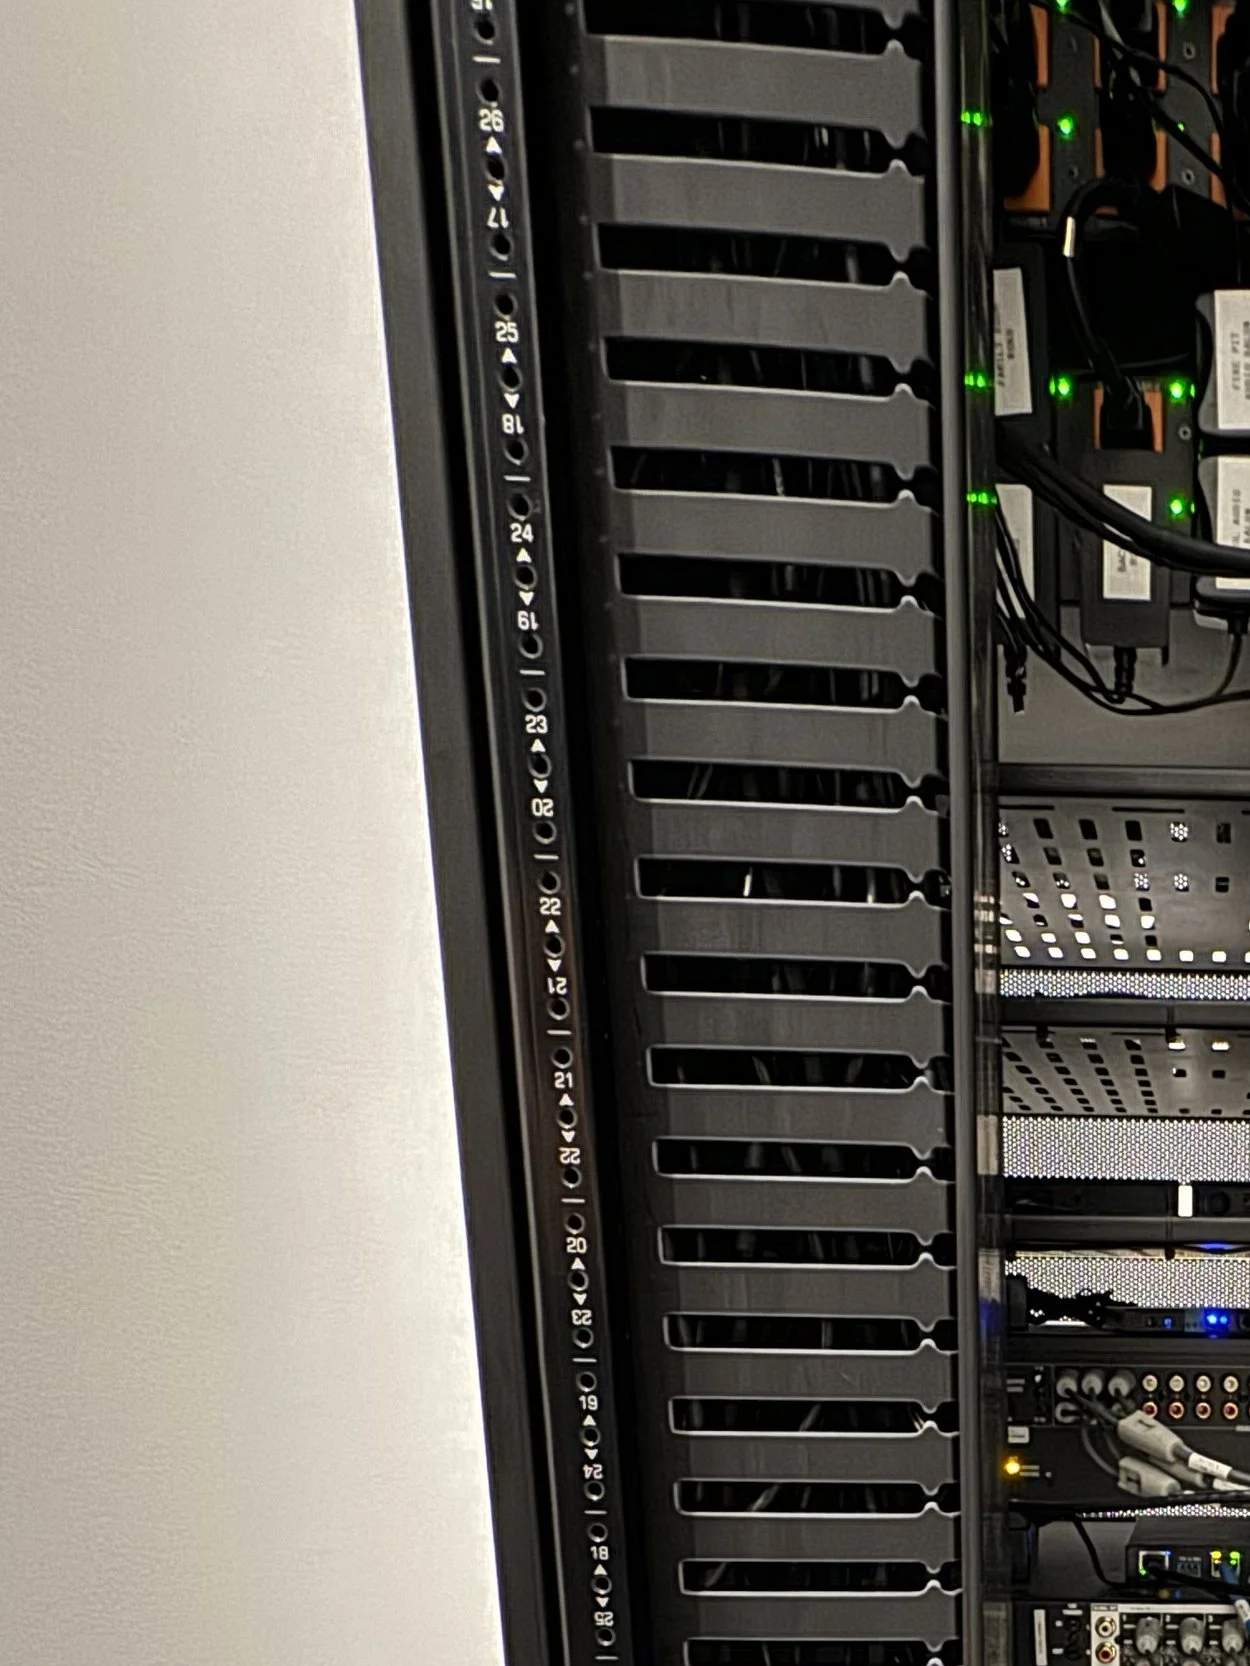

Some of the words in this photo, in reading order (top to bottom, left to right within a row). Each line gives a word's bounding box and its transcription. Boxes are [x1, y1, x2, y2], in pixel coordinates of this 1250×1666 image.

[479, 109, 503, 131] 26
[487, 208, 509, 227] 17
[496, 324, 518, 342] 25
[503, 415, 524, 434] 18
[511, 525, 533, 542] 24
[525, 715, 547, 734] 23
[532, 799, 553, 816] 20
[540, 898, 560, 915] 22
[548, 977, 567, 994] 21
[555, 1072, 573, 1088] 21
[566, 1237, 587, 1253] 20
[579, 1396, 598, 1410] 19
[591, 1546, 609, 1561] 18
